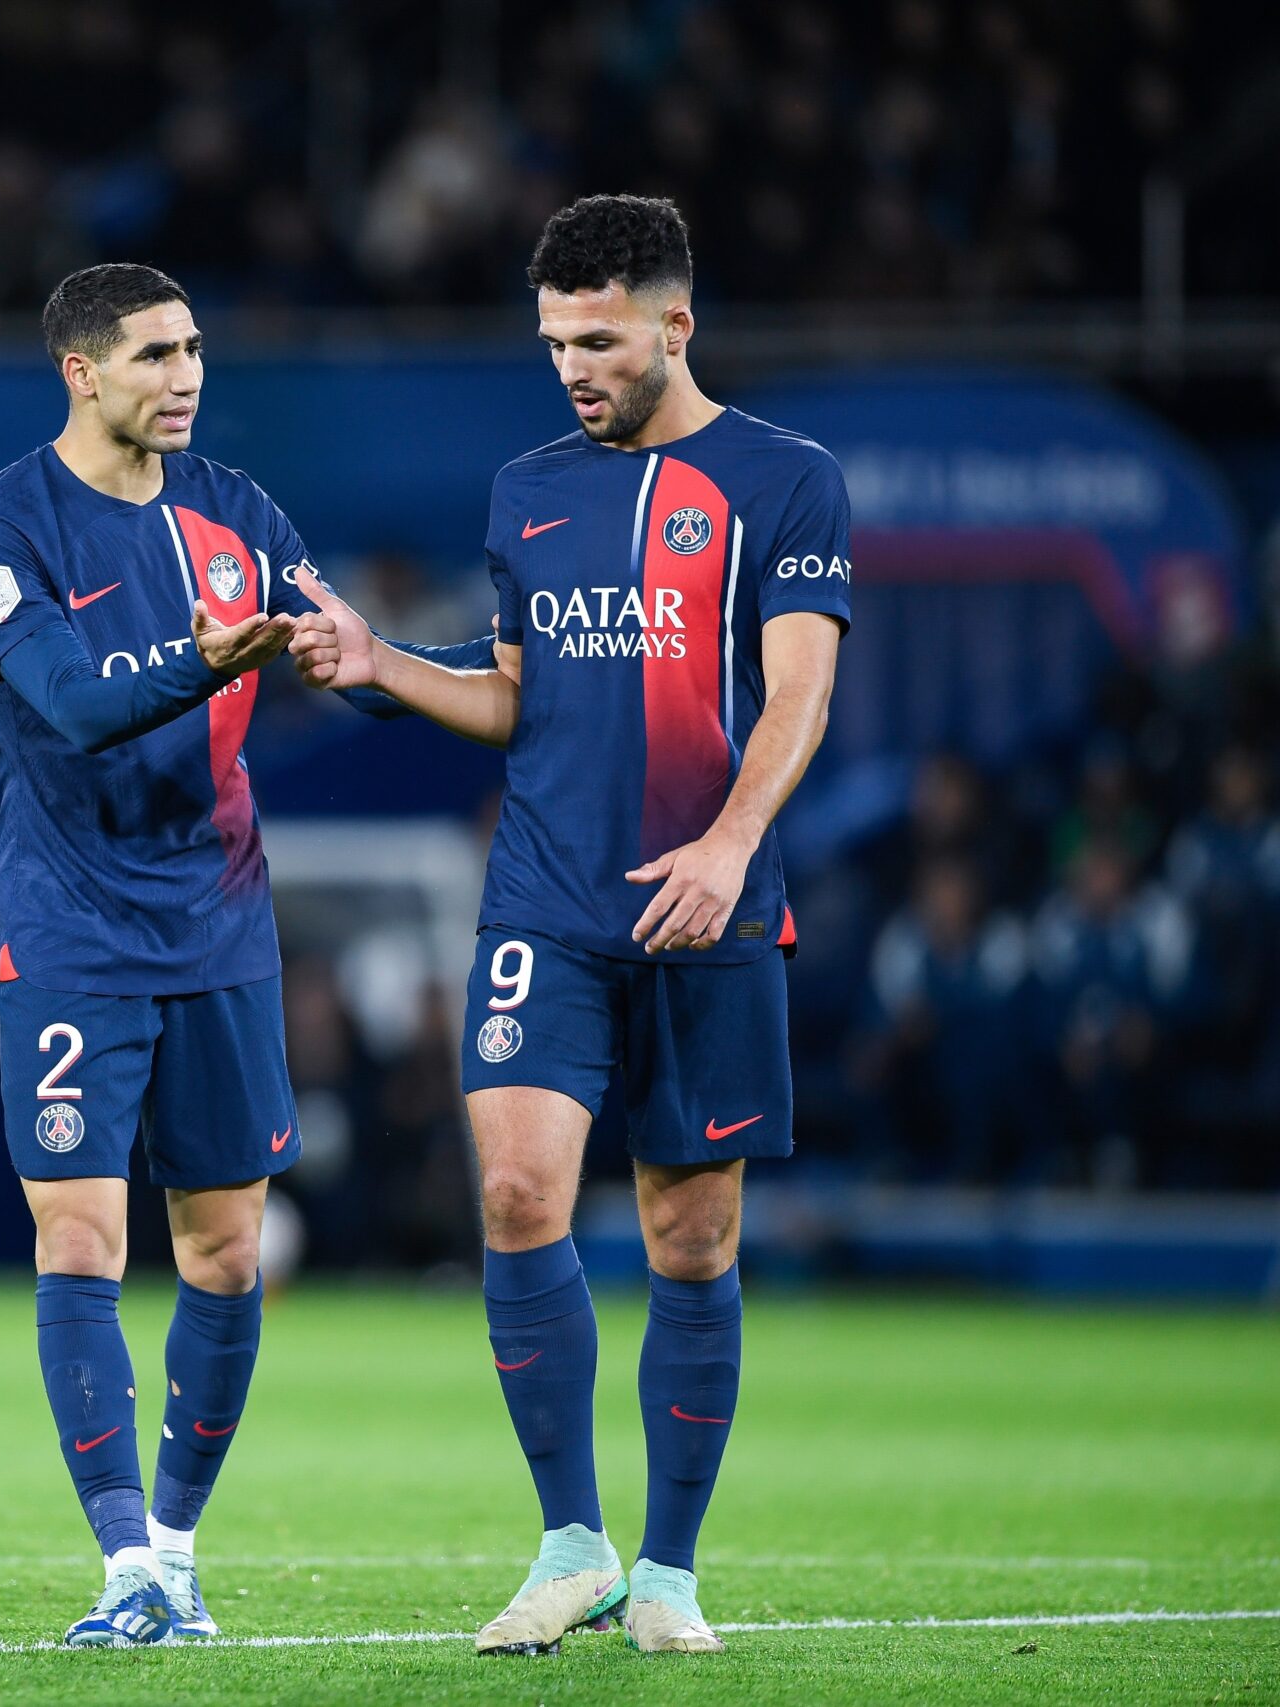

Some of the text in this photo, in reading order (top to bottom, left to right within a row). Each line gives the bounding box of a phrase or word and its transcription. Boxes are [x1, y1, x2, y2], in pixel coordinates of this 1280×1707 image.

[672, 510, 704, 522] PARIS
[211, 556, 234, 570] PARIS
[530, 586, 686, 640] QATAR
[558, 632, 687, 659] AIRWAYS
[487, 940, 534, 1011] 9
[484, 1018, 514, 1031] PARIS
[36, 1023, 83, 1100] 2
[43, 1106, 75, 1119] PARIS
